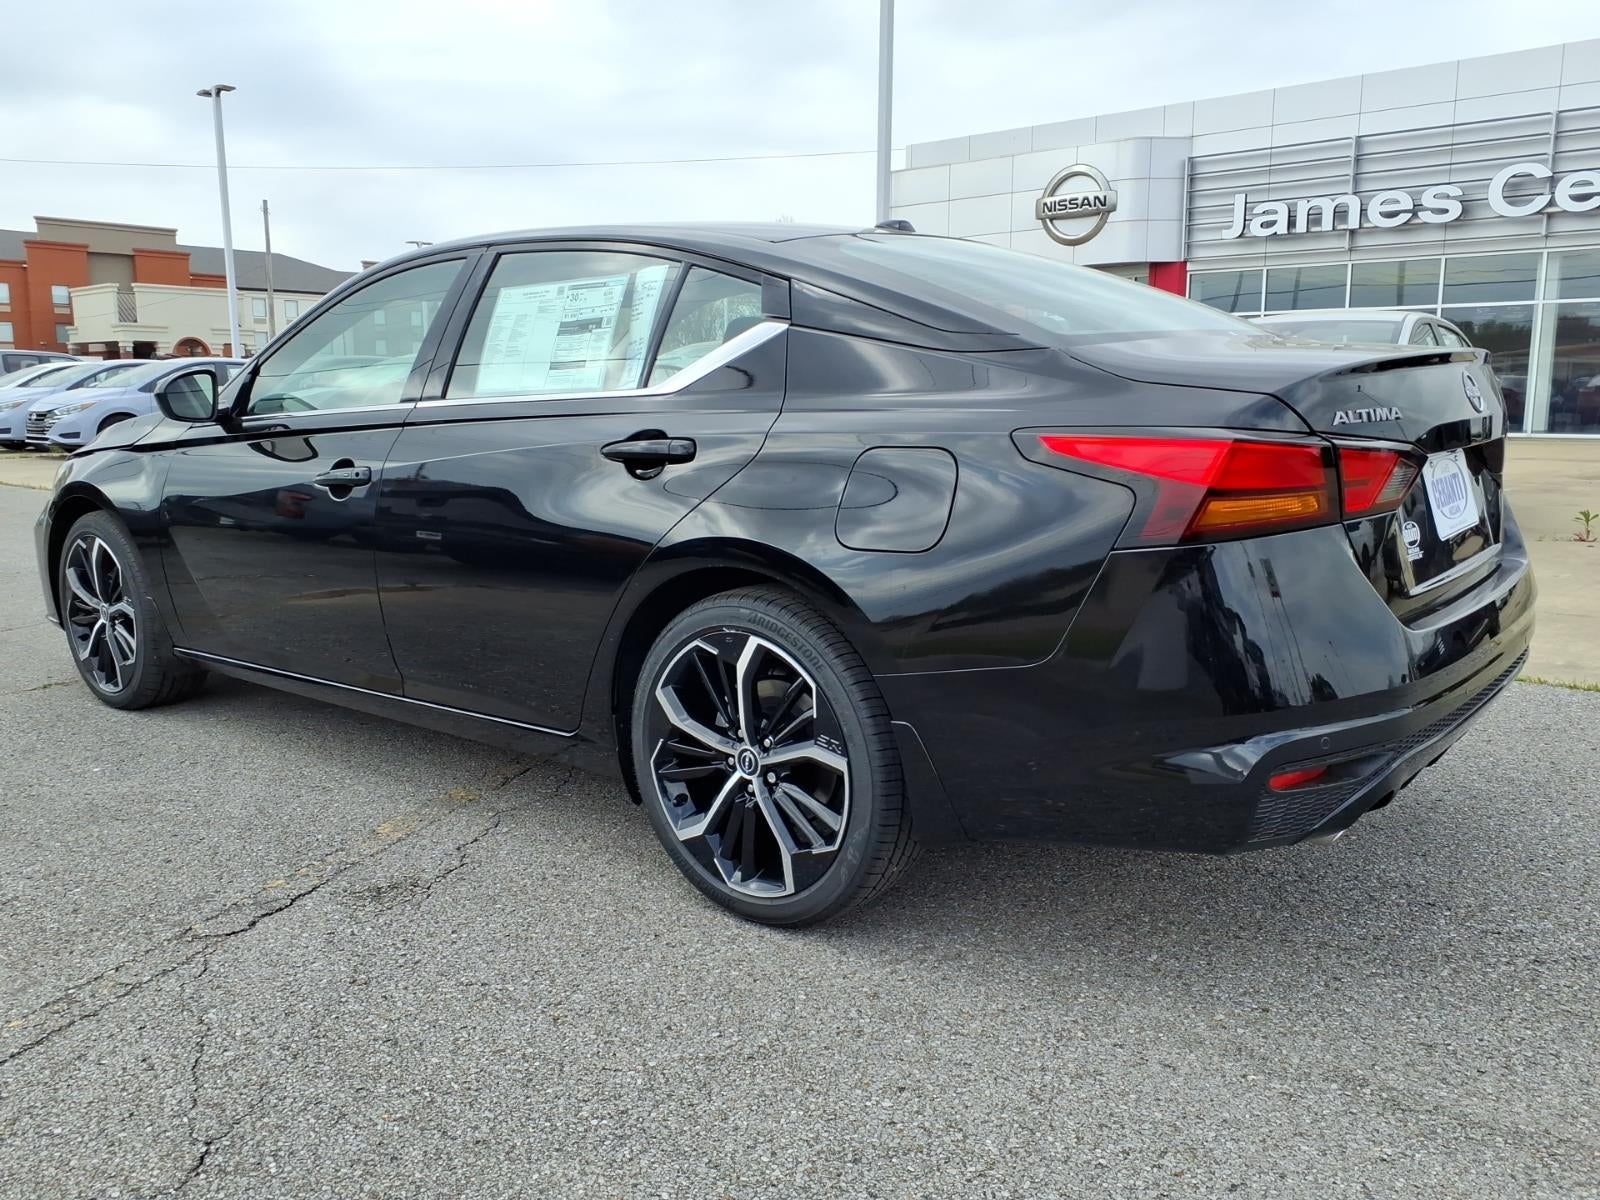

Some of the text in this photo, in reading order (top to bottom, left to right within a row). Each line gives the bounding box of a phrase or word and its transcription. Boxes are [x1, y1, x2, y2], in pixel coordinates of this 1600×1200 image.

[1042, 194, 1107, 214] NISSAN
[1221, 184, 1464, 240] James
[1332, 406, 1403, 426] ALTIMA
[747, 612, 825, 674] BRIDGESTONE
